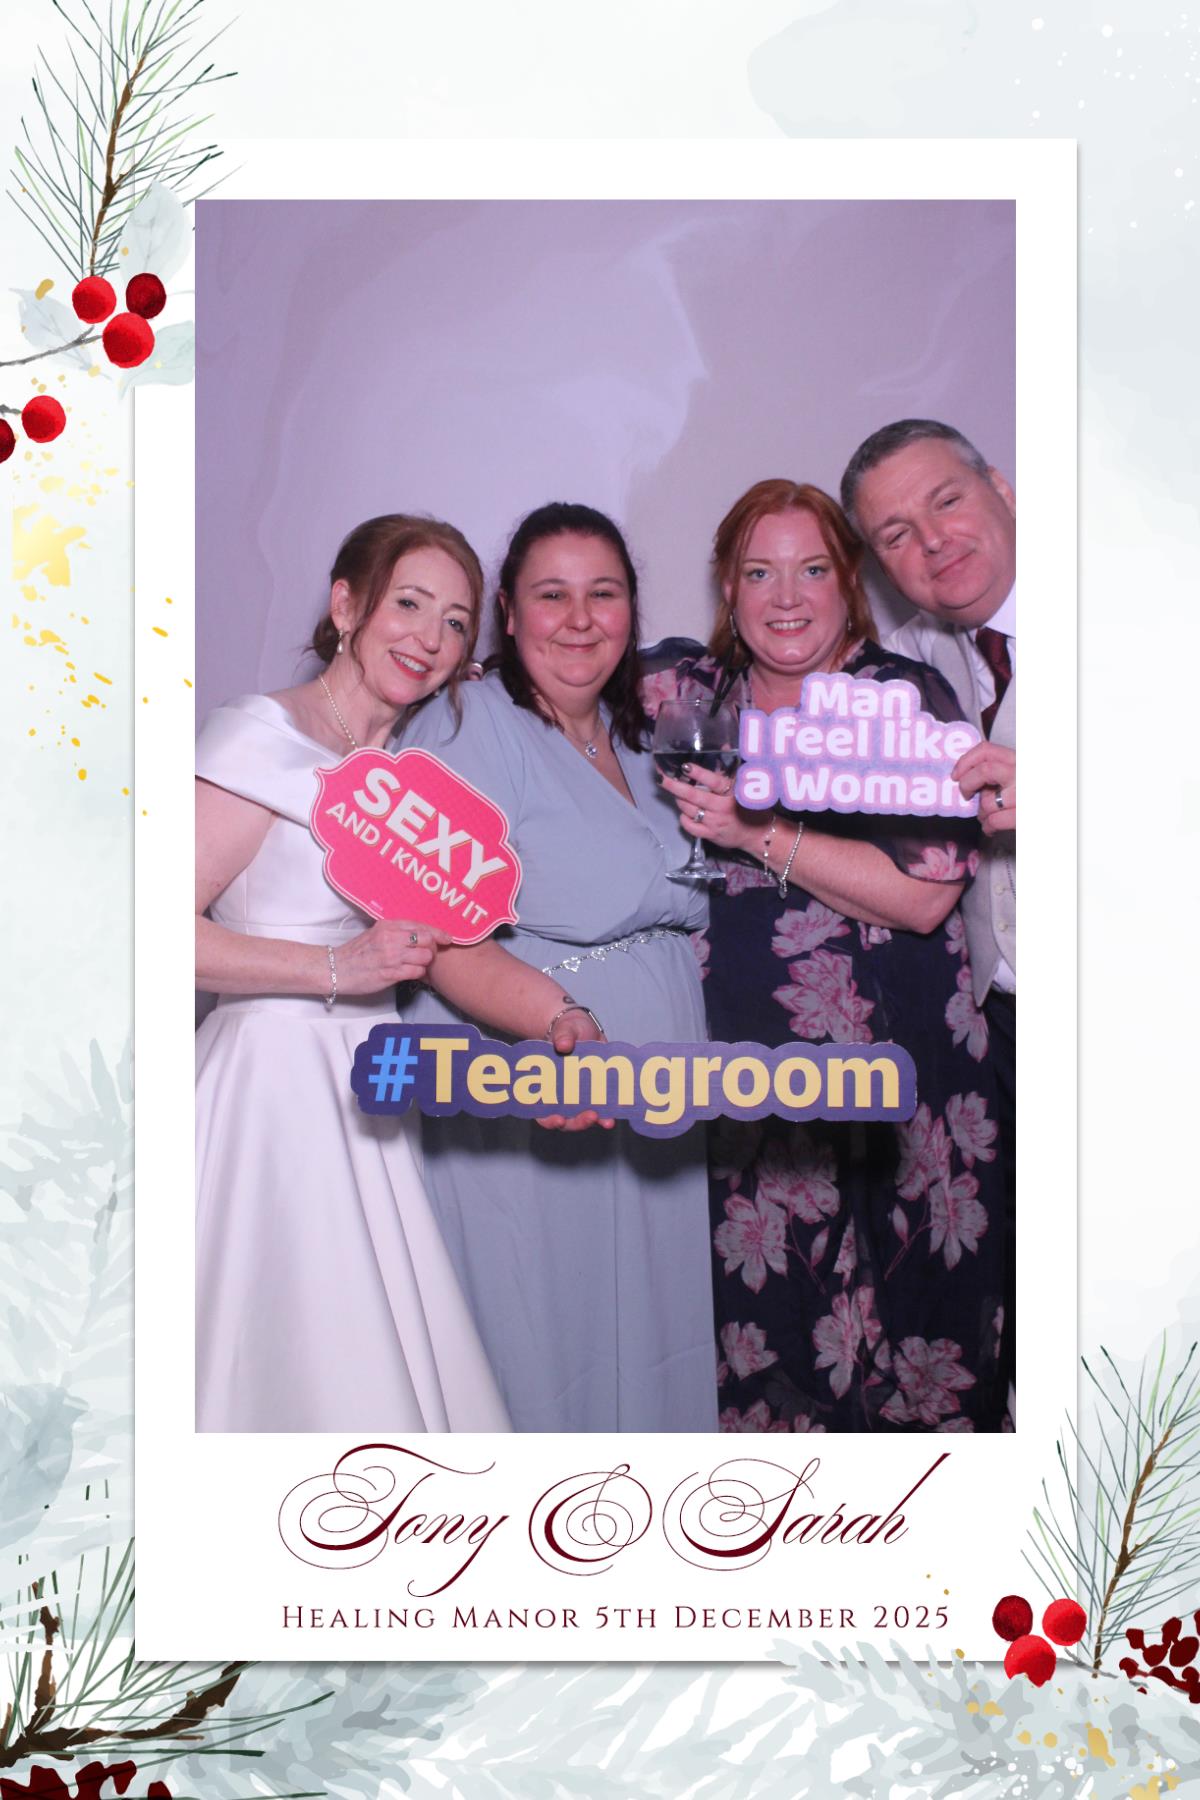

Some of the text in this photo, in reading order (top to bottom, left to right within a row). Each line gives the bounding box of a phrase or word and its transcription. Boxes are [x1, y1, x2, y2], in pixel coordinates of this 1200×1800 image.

[809, 681, 910, 718] Man
[748, 716, 972, 760] I feel like
[743, 770, 770, 801] a
[353, 768, 508, 890] SEXY
[325, 802, 488, 925] AND I KNOW IT
[368, 1037, 900, 1125] #Teamgroom
